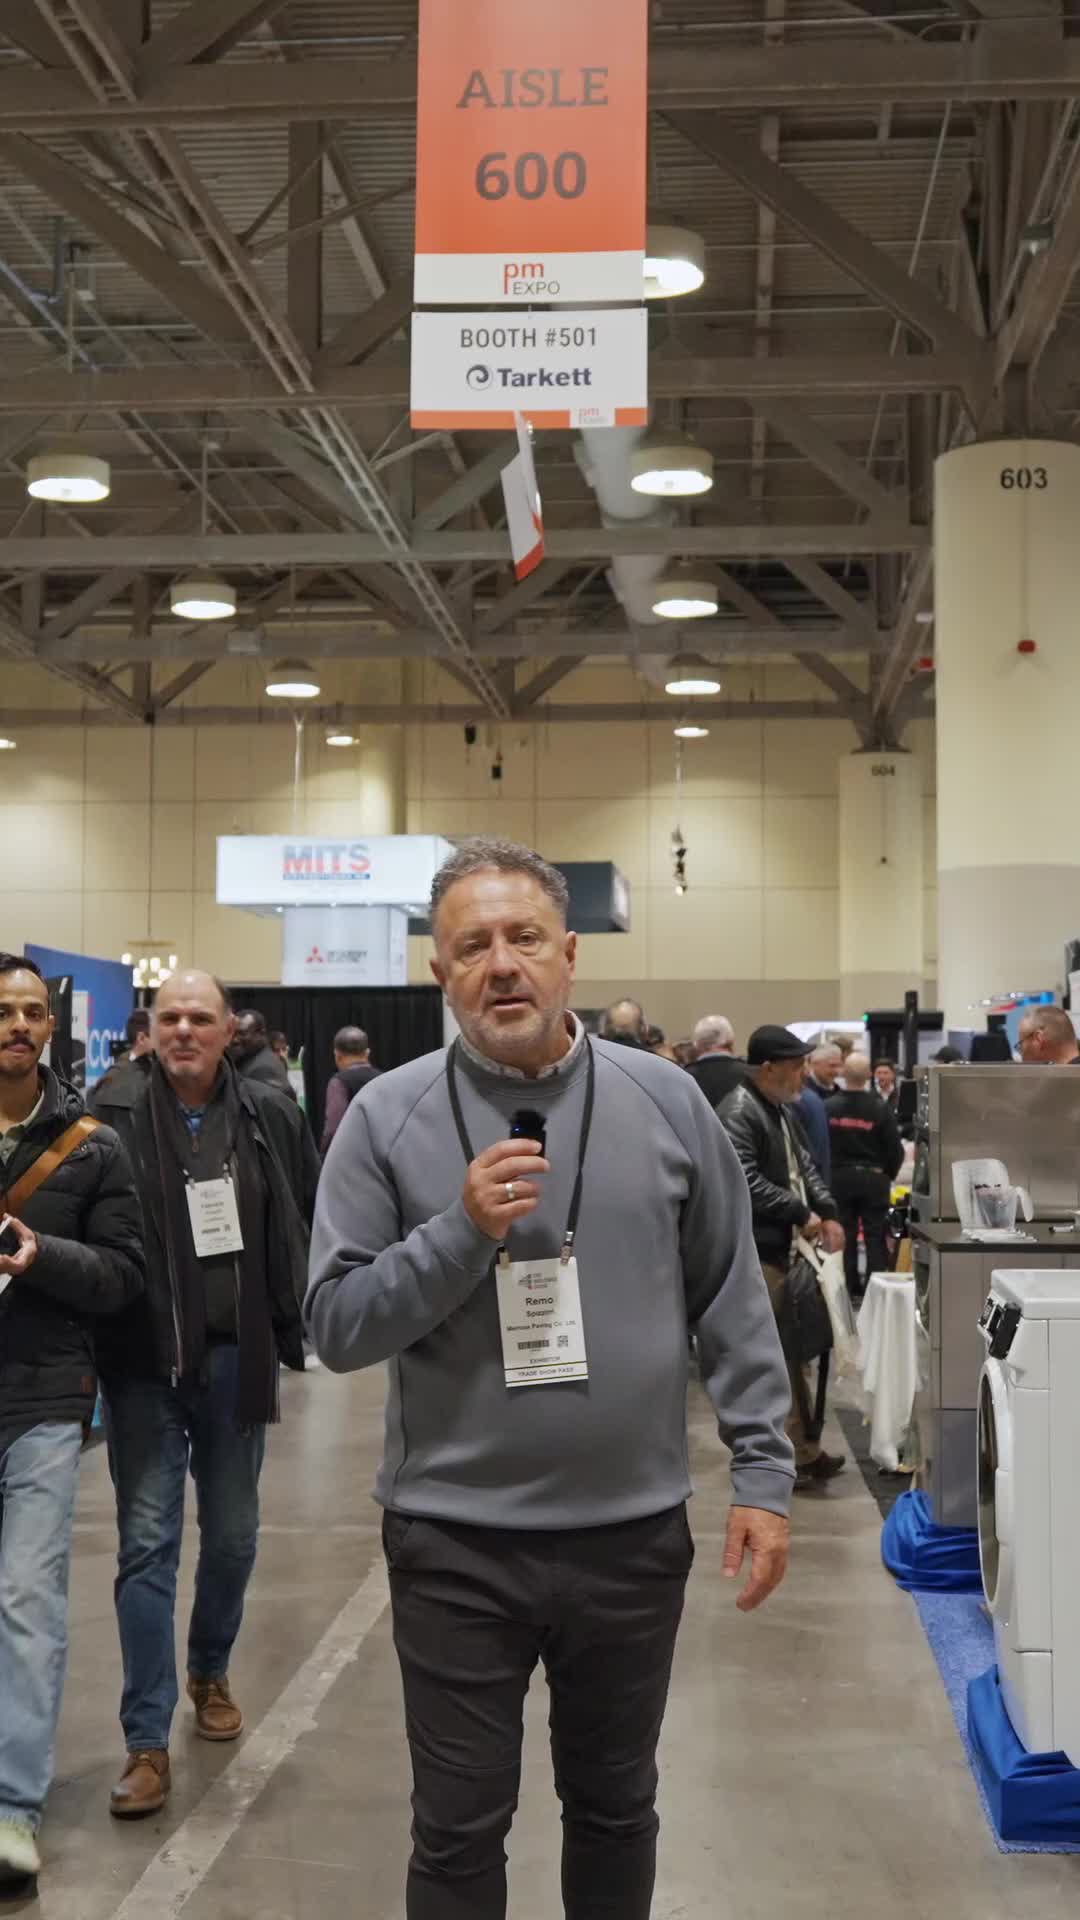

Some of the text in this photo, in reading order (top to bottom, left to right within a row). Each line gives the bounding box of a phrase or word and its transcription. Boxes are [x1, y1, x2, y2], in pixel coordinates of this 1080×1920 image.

[456, 67, 609, 109] AISLE
[475, 151, 587, 200] 600
[504, 262, 545, 294] pm
[512, 281, 561, 295] EXPO
[460, 327, 597, 348] BOOTH #501
[497, 368, 592, 388] Tarkett
[1000, 467, 1048, 489] 603
[283, 844, 370, 873] MITS
[525, 1297, 554, 1306] Remo
